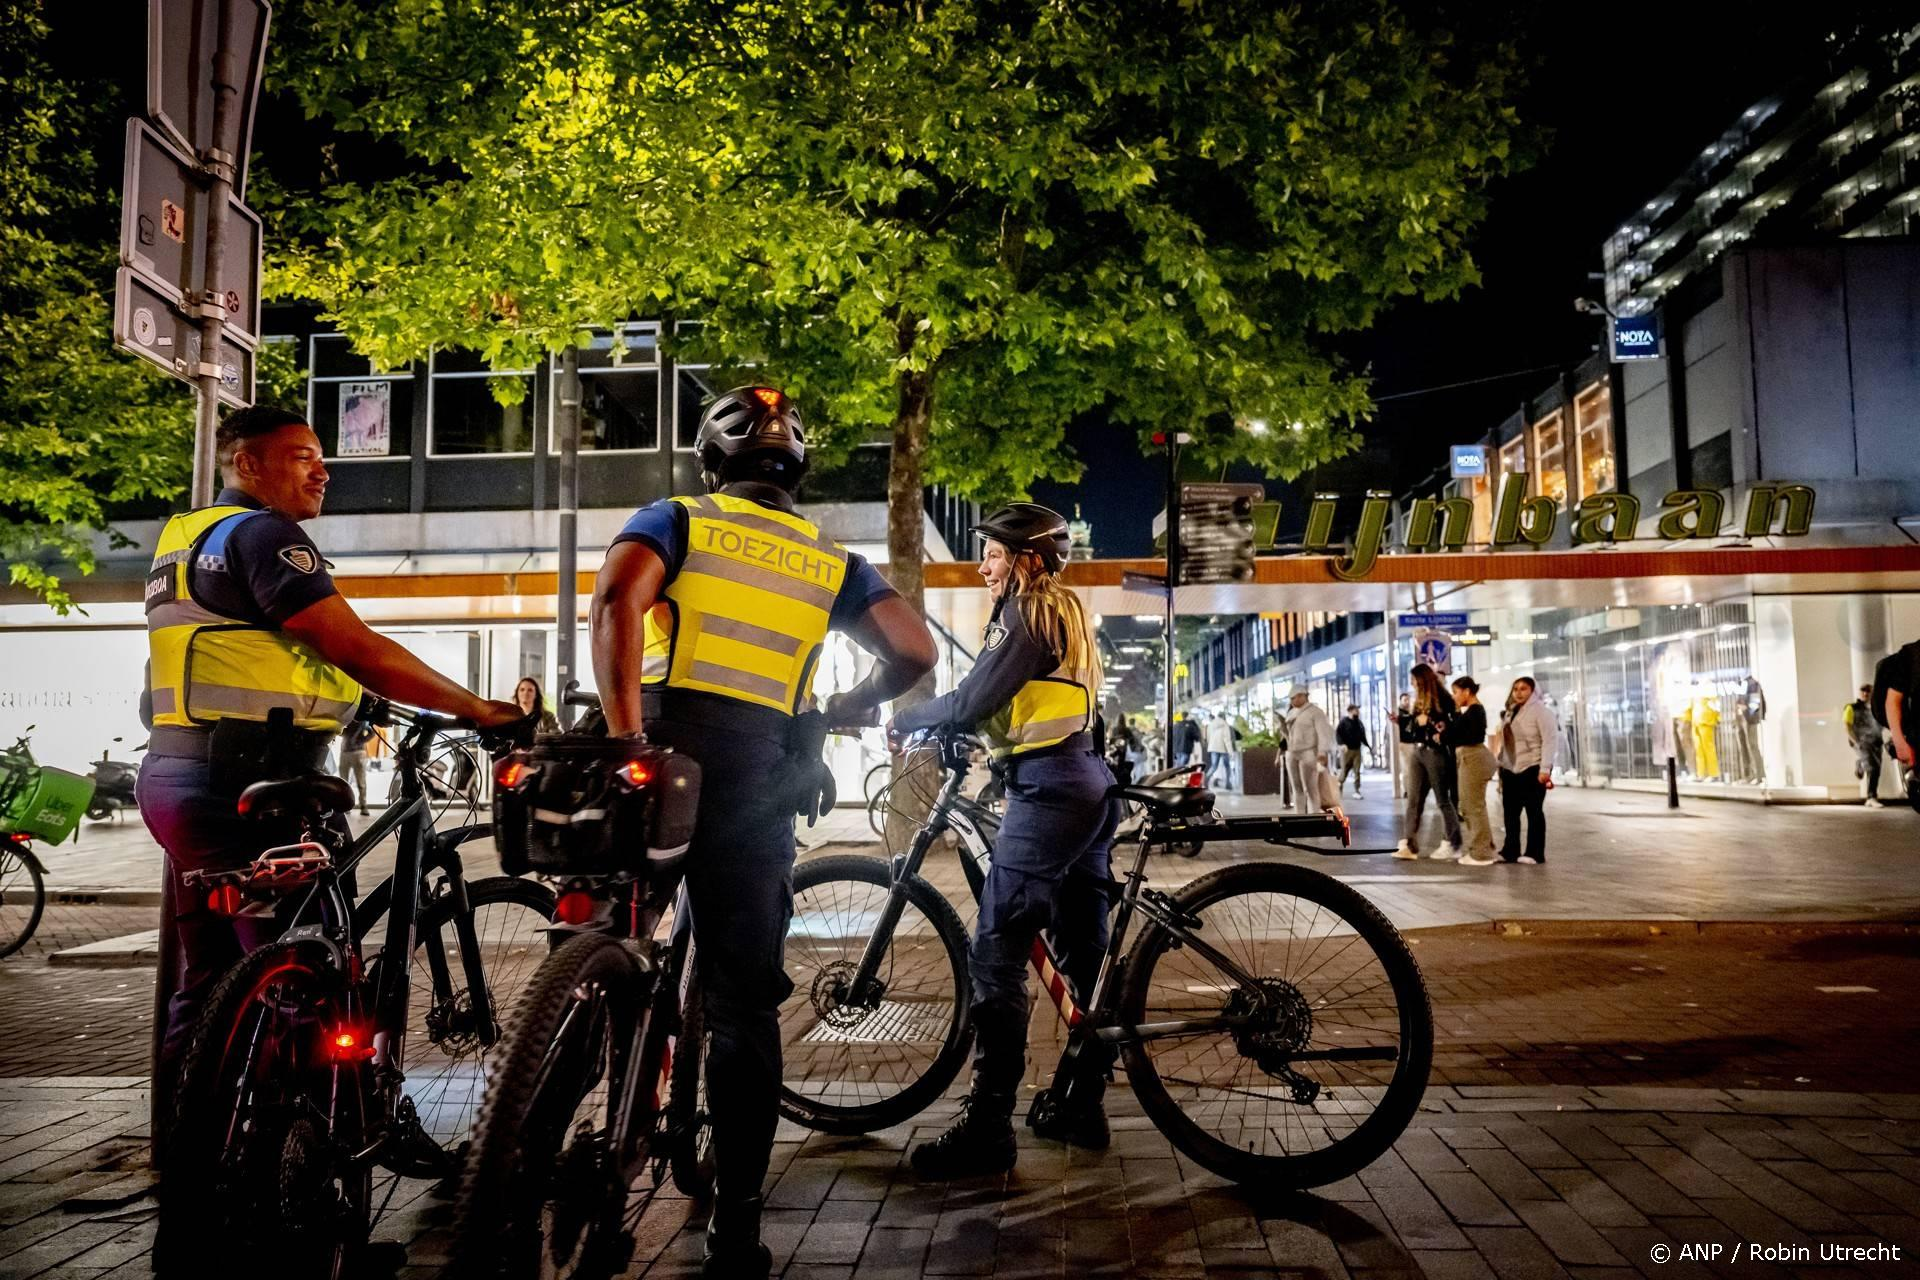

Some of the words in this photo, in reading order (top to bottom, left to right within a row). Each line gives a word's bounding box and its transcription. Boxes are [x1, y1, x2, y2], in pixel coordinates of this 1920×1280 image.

[352, 383, 389, 394] FILM
[703, 525, 838, 583] TOEZICHT
[35, 809, 66, 826] Eats
